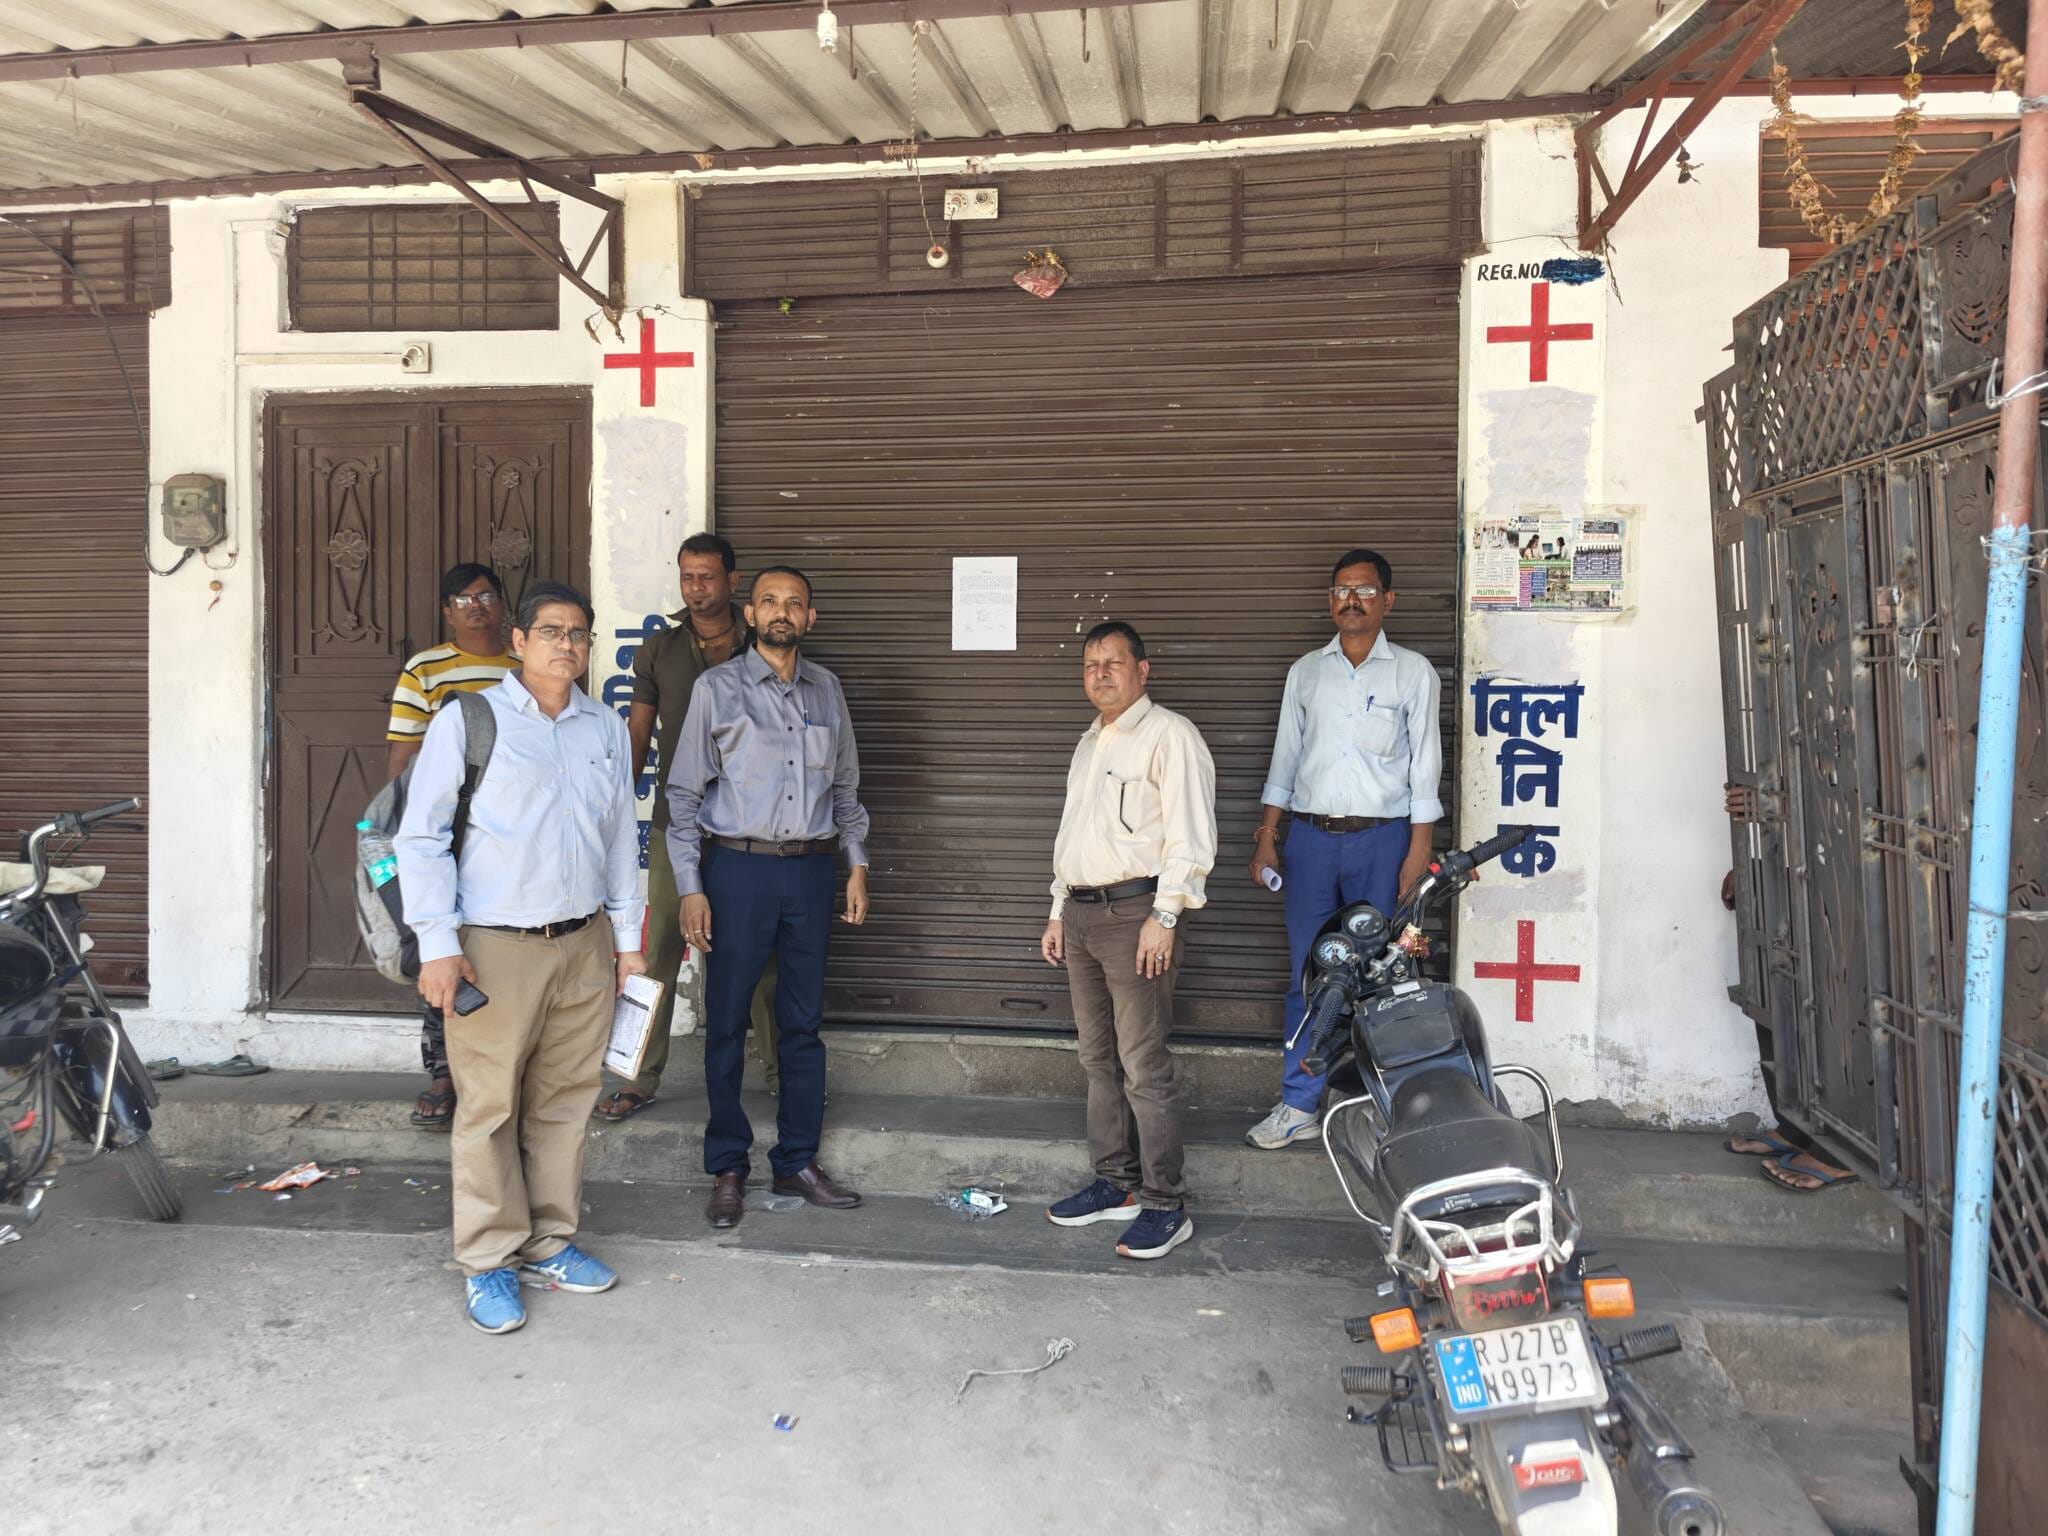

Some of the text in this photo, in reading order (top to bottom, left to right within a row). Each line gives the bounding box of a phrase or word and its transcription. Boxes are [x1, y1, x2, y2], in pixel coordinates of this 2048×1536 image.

[1472, 1325, 1568, 1366] RJ27B
[1455, 1383, 1482, 1405] IND
[1485, 1361, 1577, 1403] N9973
